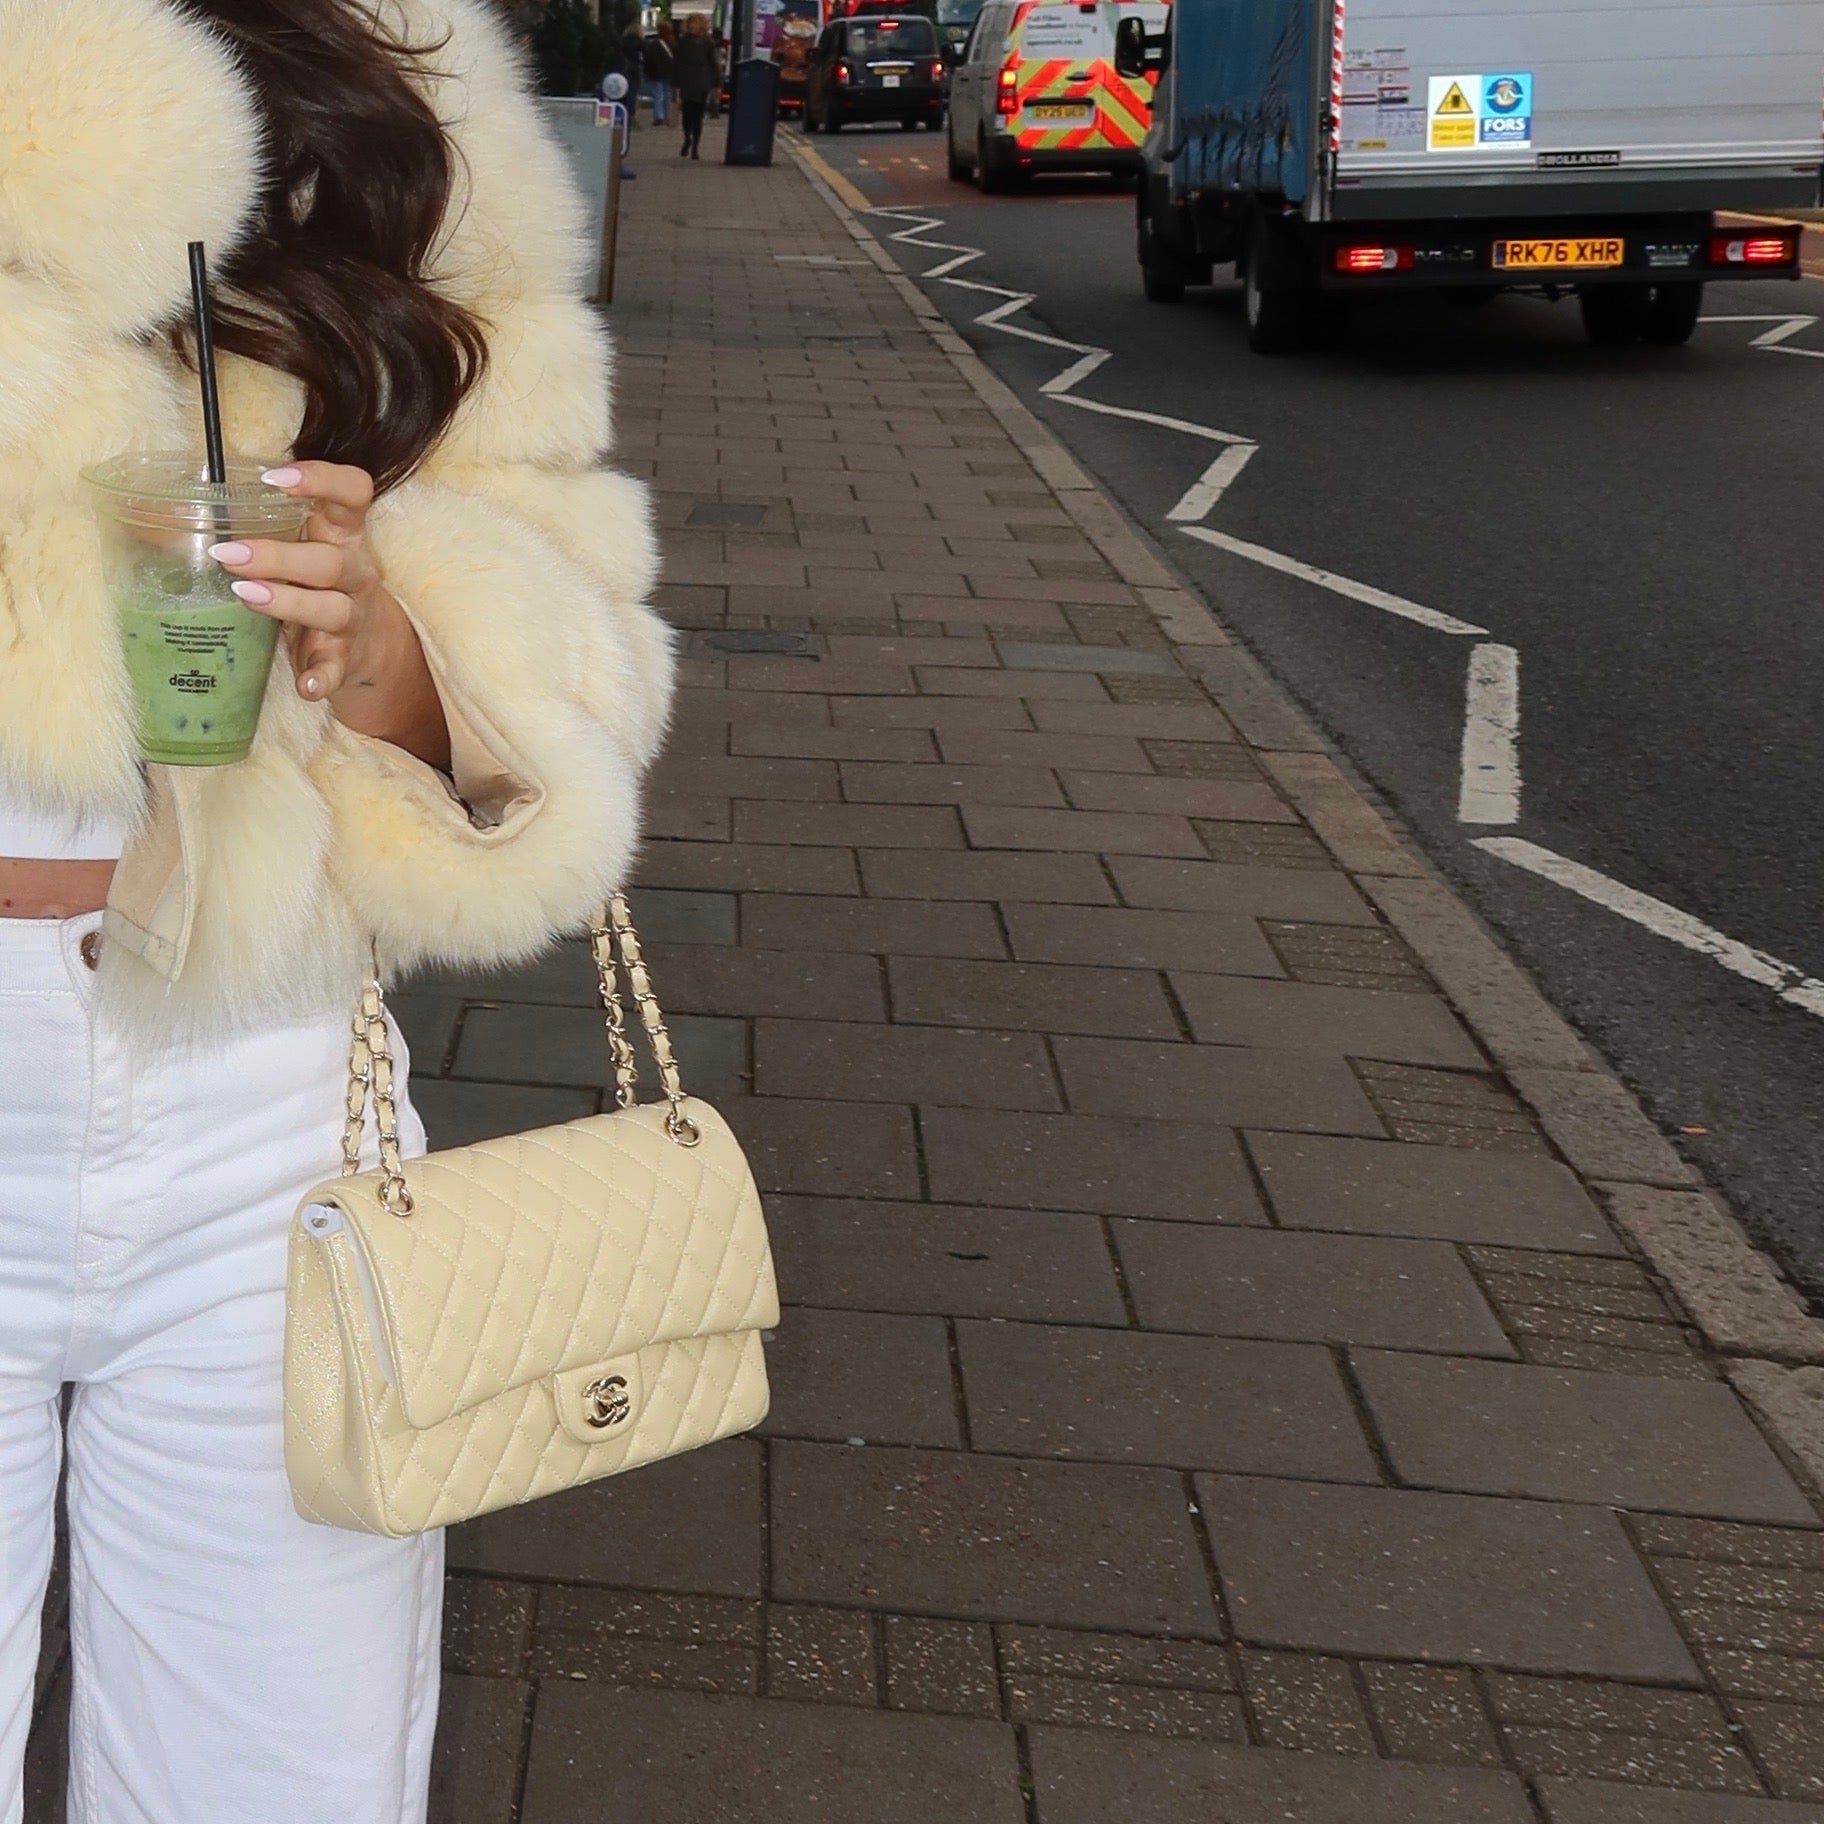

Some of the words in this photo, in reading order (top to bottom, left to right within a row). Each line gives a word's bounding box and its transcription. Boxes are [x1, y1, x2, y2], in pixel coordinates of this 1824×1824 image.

[1484, 118, 1526, 132] FORS
[1509, 242, 1569, 264] RK76
[1574, 240, 1620, 262] XHR
[169, 674, 217, 688] decent
